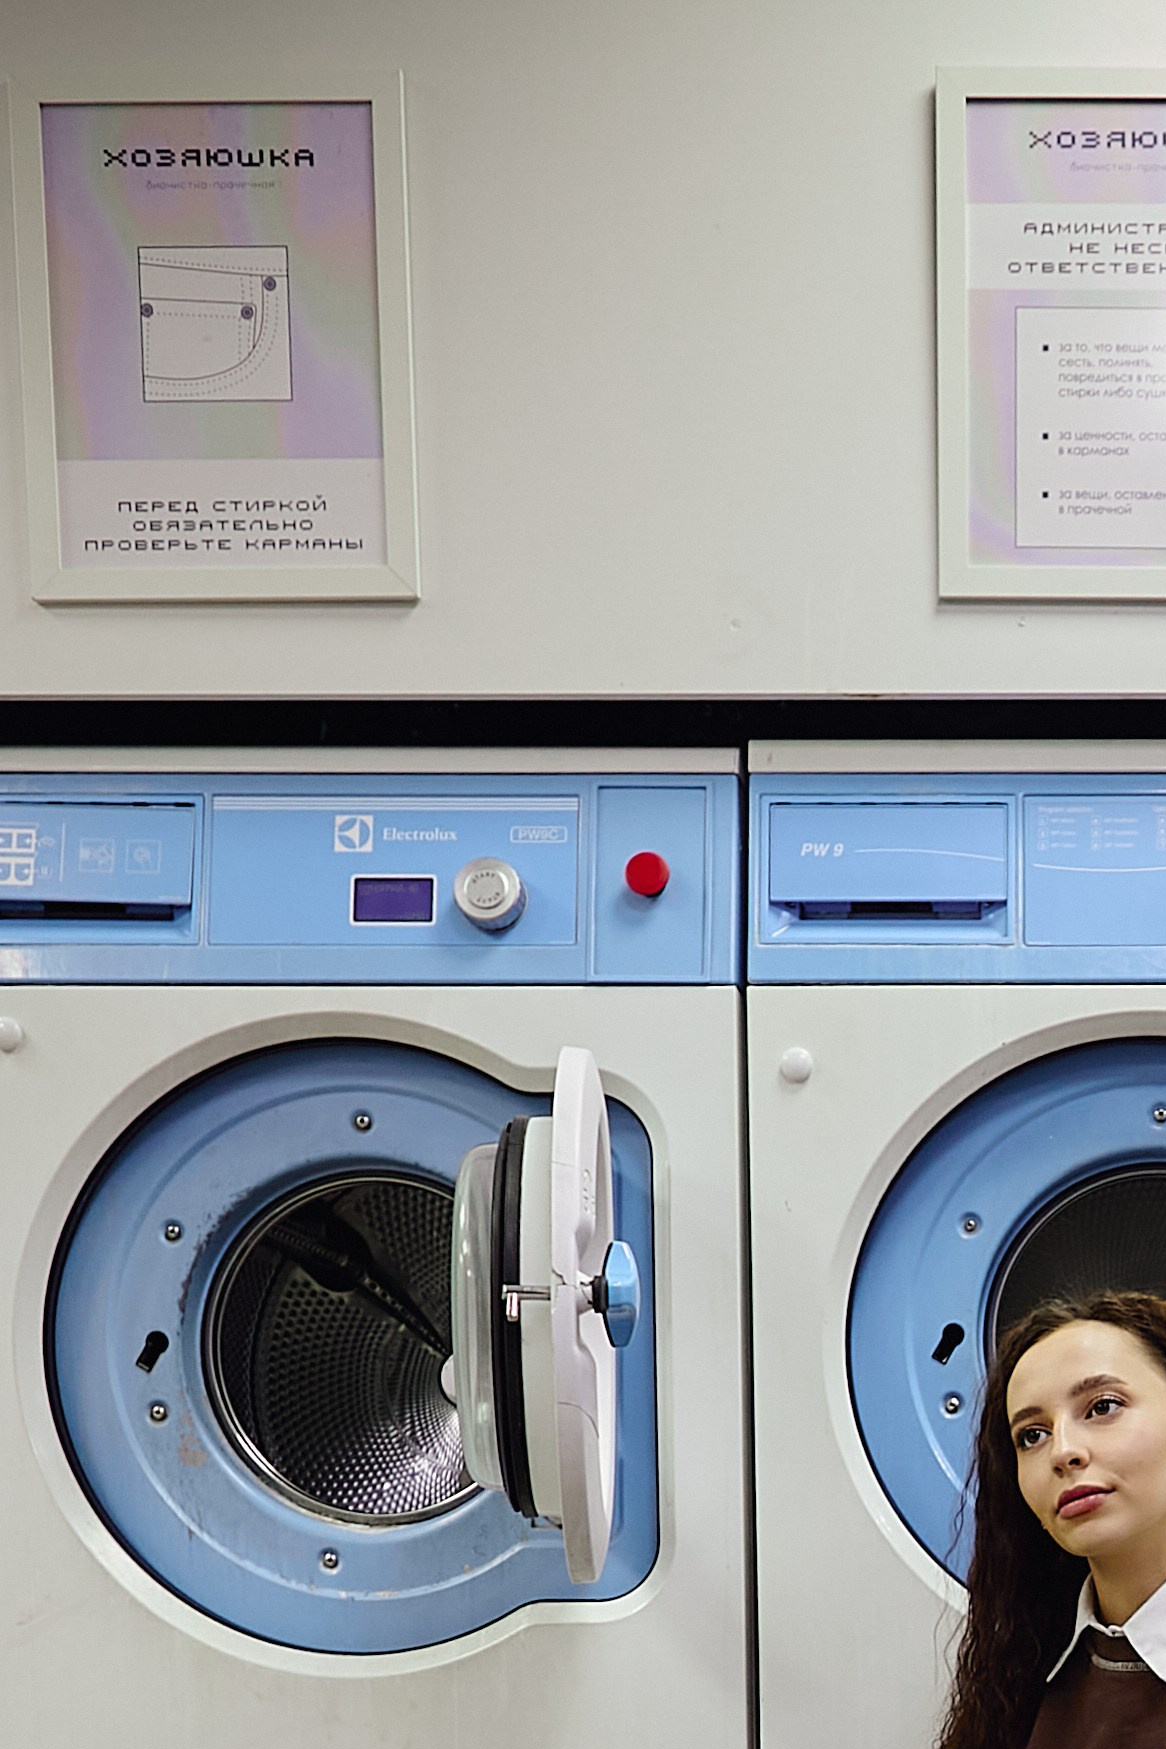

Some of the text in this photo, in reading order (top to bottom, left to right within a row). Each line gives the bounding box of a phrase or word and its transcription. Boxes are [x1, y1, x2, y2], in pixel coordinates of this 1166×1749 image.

[103, 148, 316, 168] ХОЗЯЮШКА
[1069, 242, 1101, 254] НЕ
[1094, 343, 1112, 353] что
[1116, 343, 1149, 354] вещи
[1058, 388, 1100, 399] стирки
[1103, 386, 1133, 398] либо
[1067, 446, 1130, 457] карманах
[118, 495, 328, 513] ПЕРЕД СТИРКОЙ
[1067, 503, 1133, 516] прачечной
[132, 519, 314, 532] ОБЯЗАТЕЛЬНО
[84, 538, 364, 551] ПРОВЕРЬТЕ КАРМАНЫ
[382, 827, 458, 841] Electrolux
[518, 828, 559, 841] PW9C
[801, 843, 844, 857] PW 9
